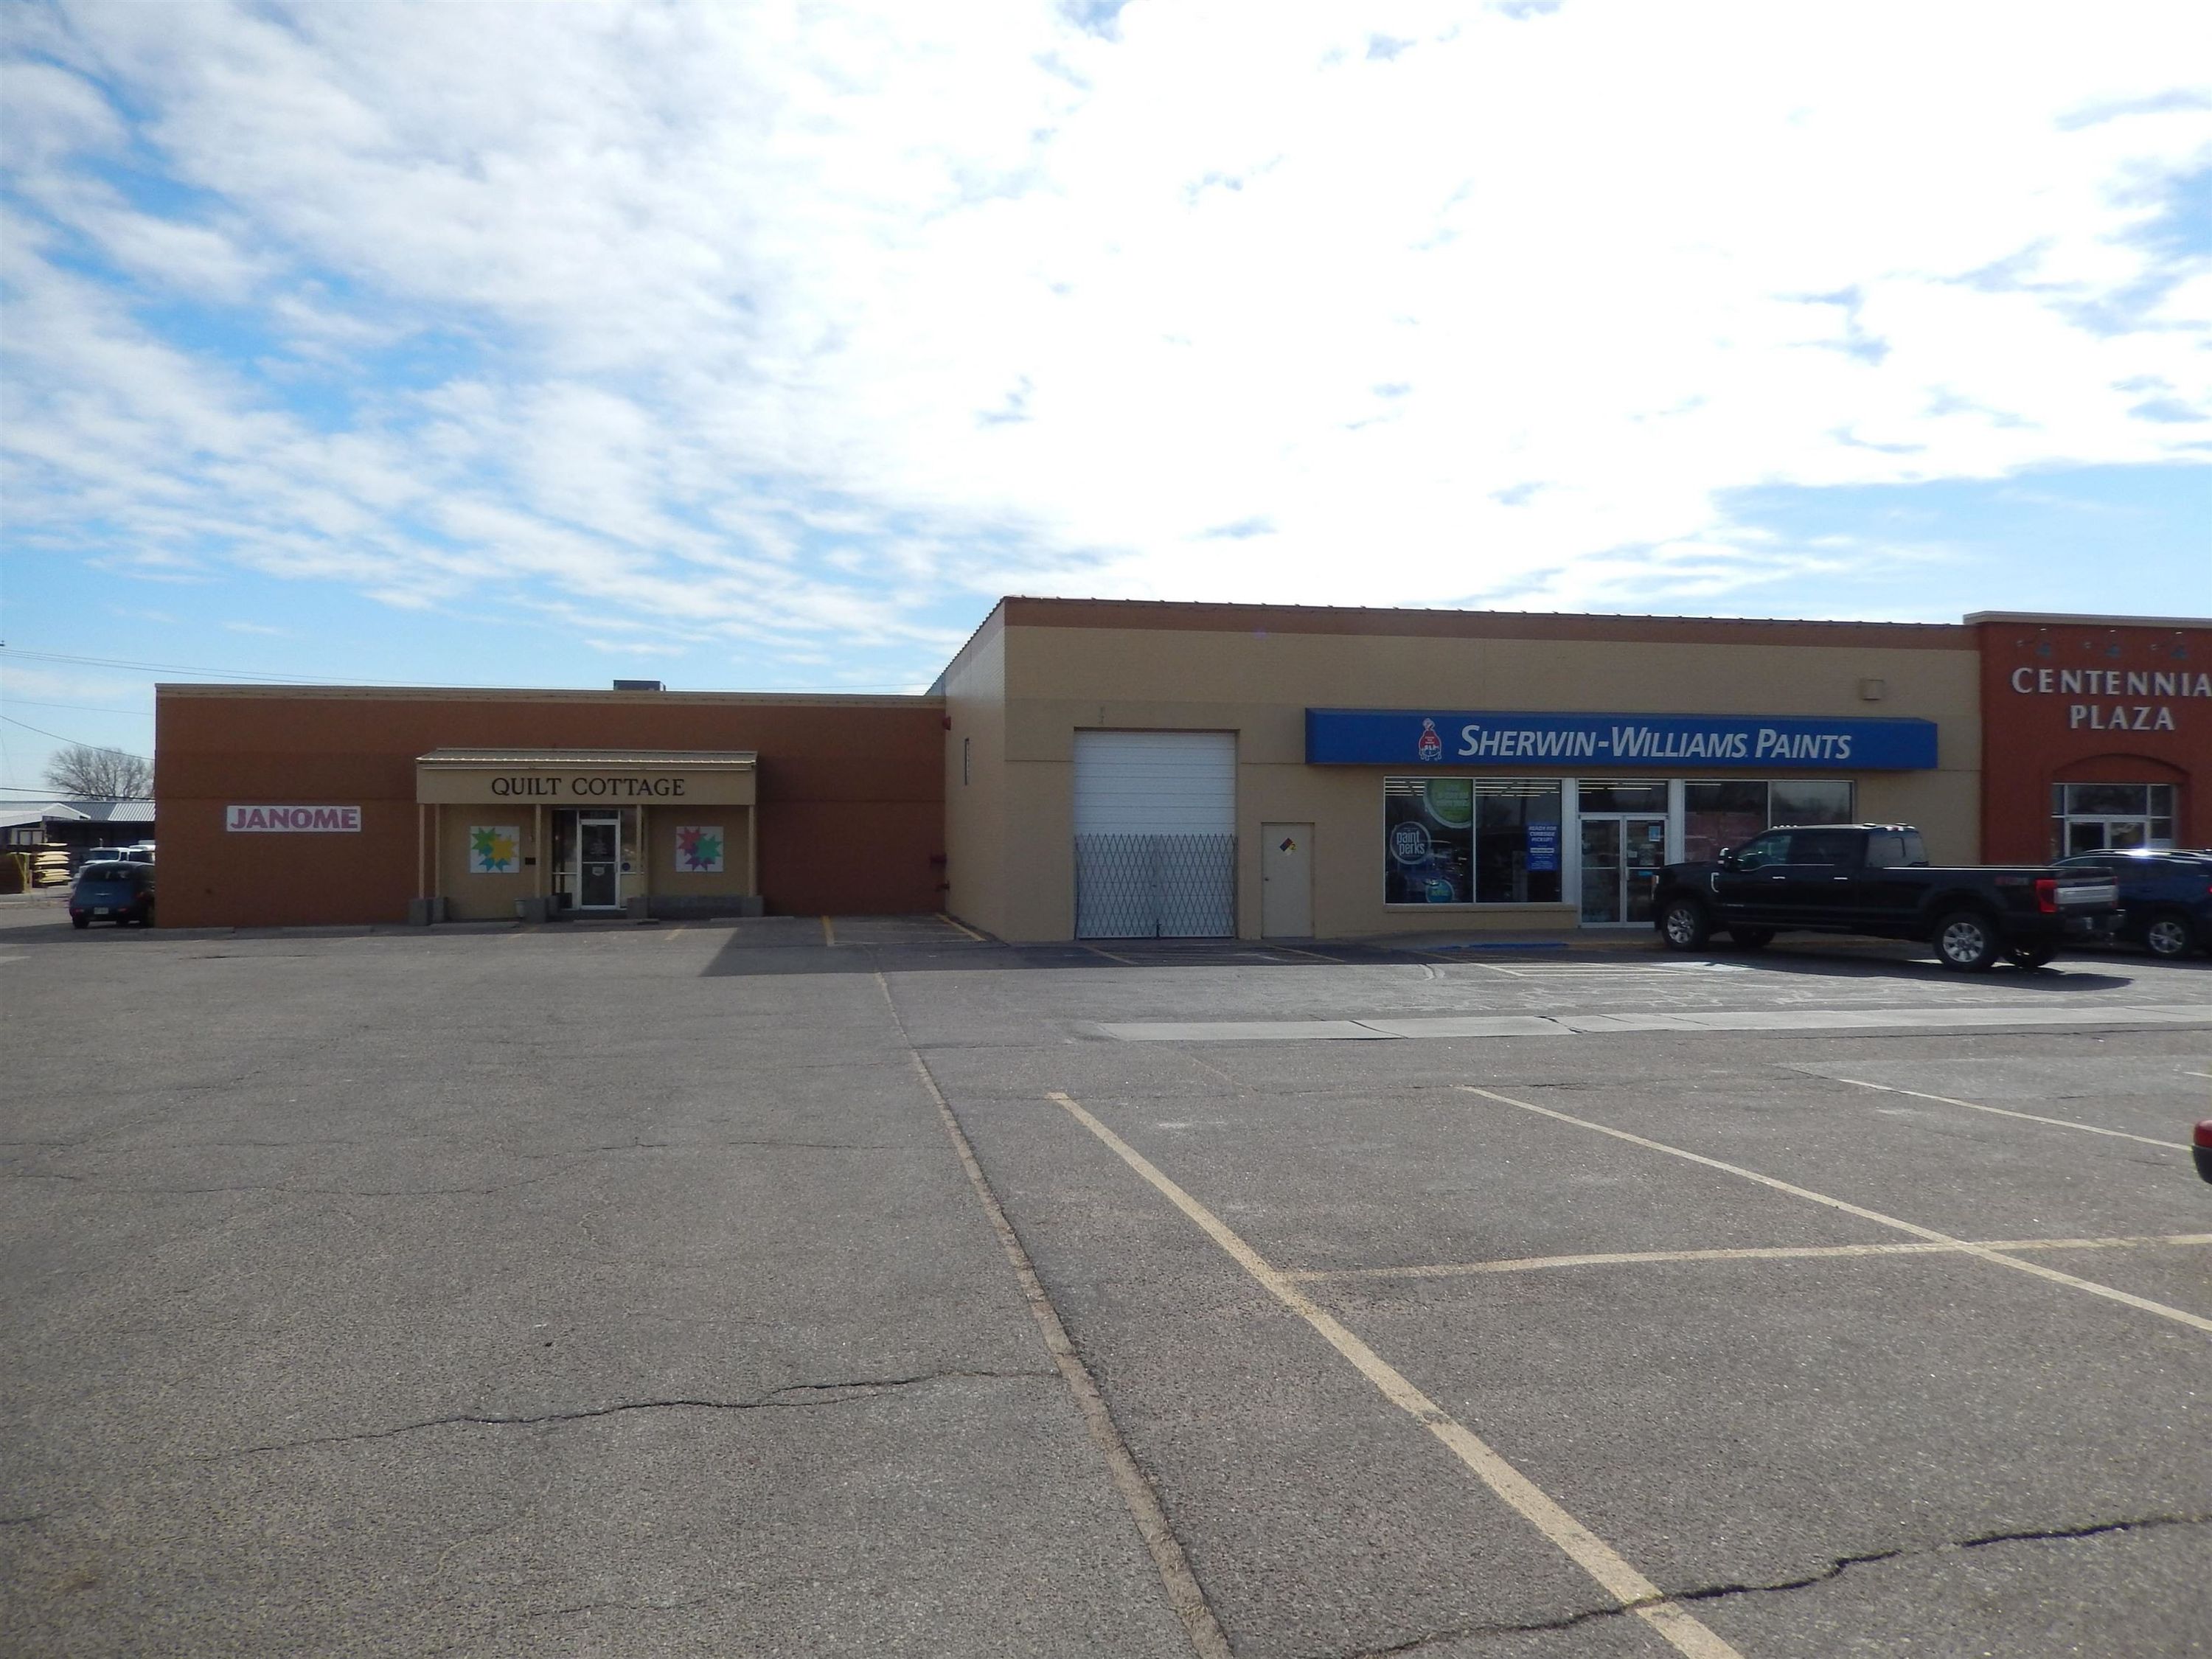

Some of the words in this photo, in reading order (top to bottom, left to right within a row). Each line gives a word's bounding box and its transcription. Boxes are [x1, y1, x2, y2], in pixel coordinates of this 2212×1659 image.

[2070, 705, 2175, 730] PLAZA
[1458, 724, 1748, 758] SHERWIN-WILLIAMS
[1755, 728, 1852, 759] PAINTS
[491, 777, 562, 796] QUILT
[571, 777, 686, 796] COTTAGE
[230, 808, 358, 829] JANOME
[1397, 830, 1420, 845] paint
[1399, 842, 1425, 856] perks
